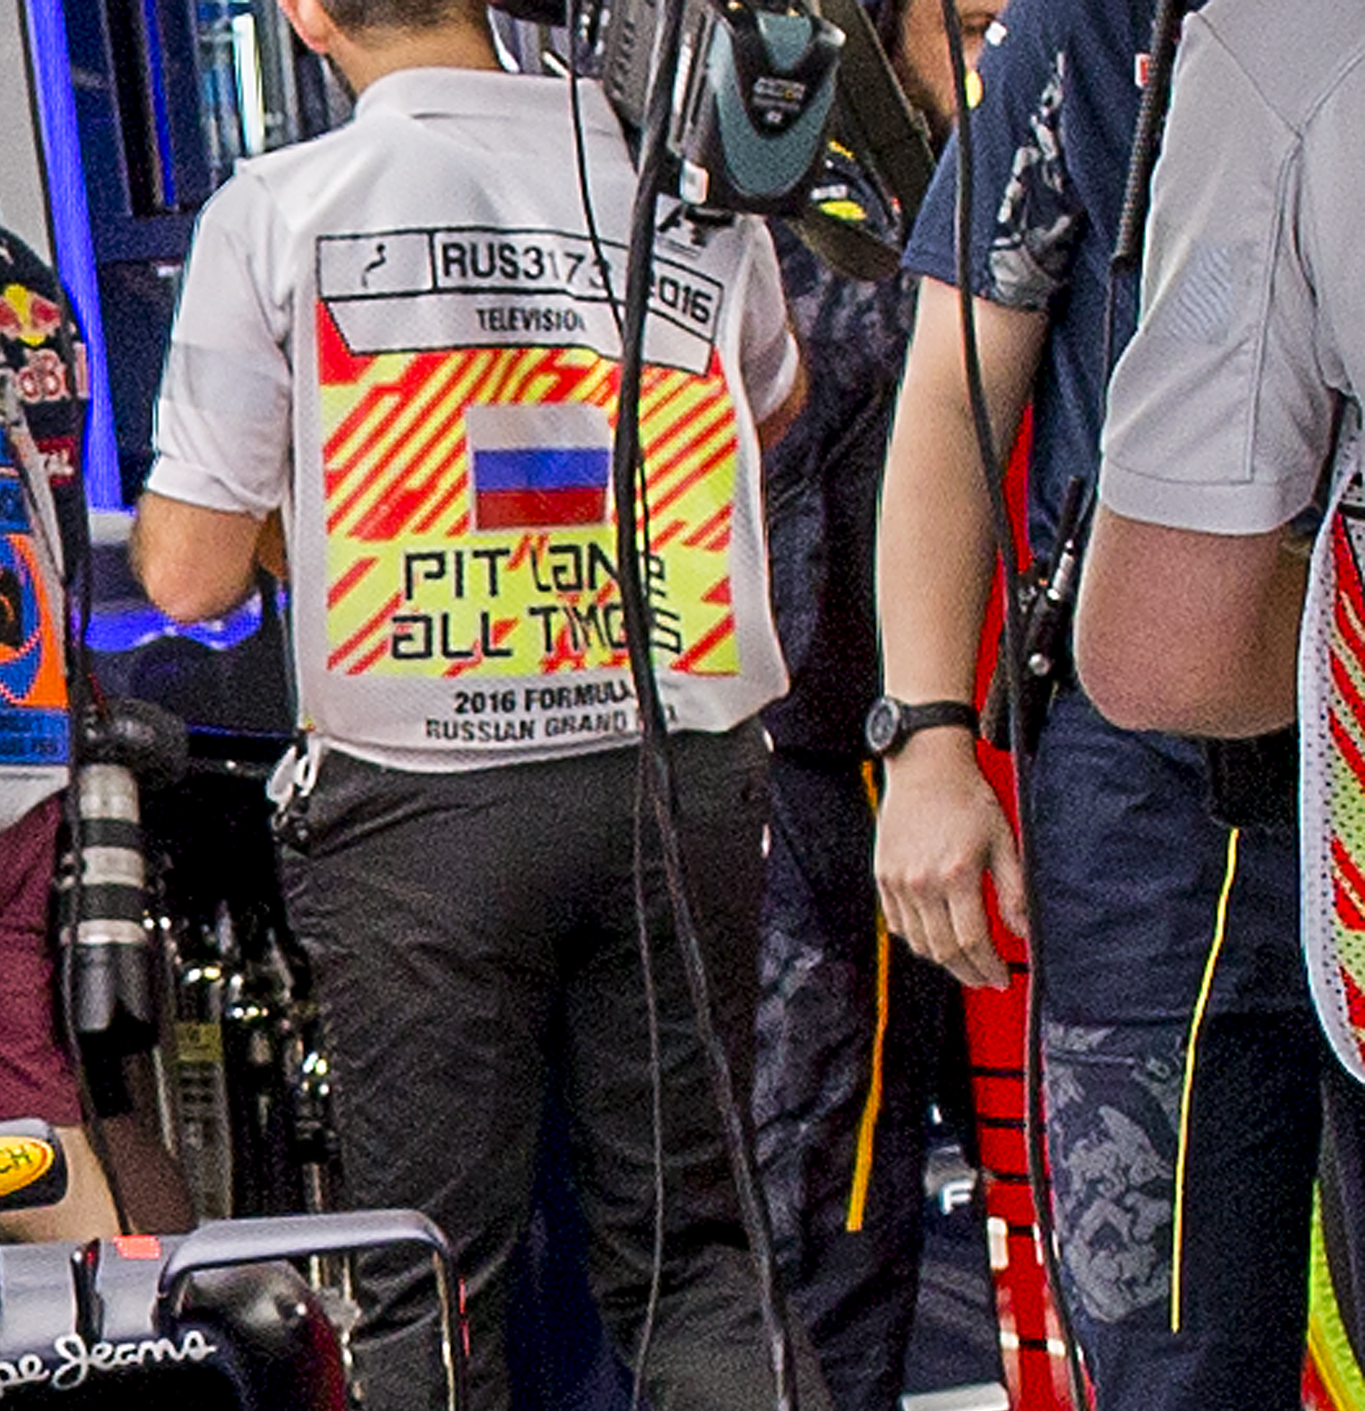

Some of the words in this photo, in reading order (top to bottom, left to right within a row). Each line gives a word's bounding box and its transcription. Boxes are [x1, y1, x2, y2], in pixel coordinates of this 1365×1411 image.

[649, 271, 713, 325] 016
[404, 547, 511, 601] PIT
[425, 717, 536, 743] RUSSIAN
[544, 709, 626, 738] GRAND
[454, 689, 517, 716] 2016
[52, 1328, 217, 1390] Jeans
